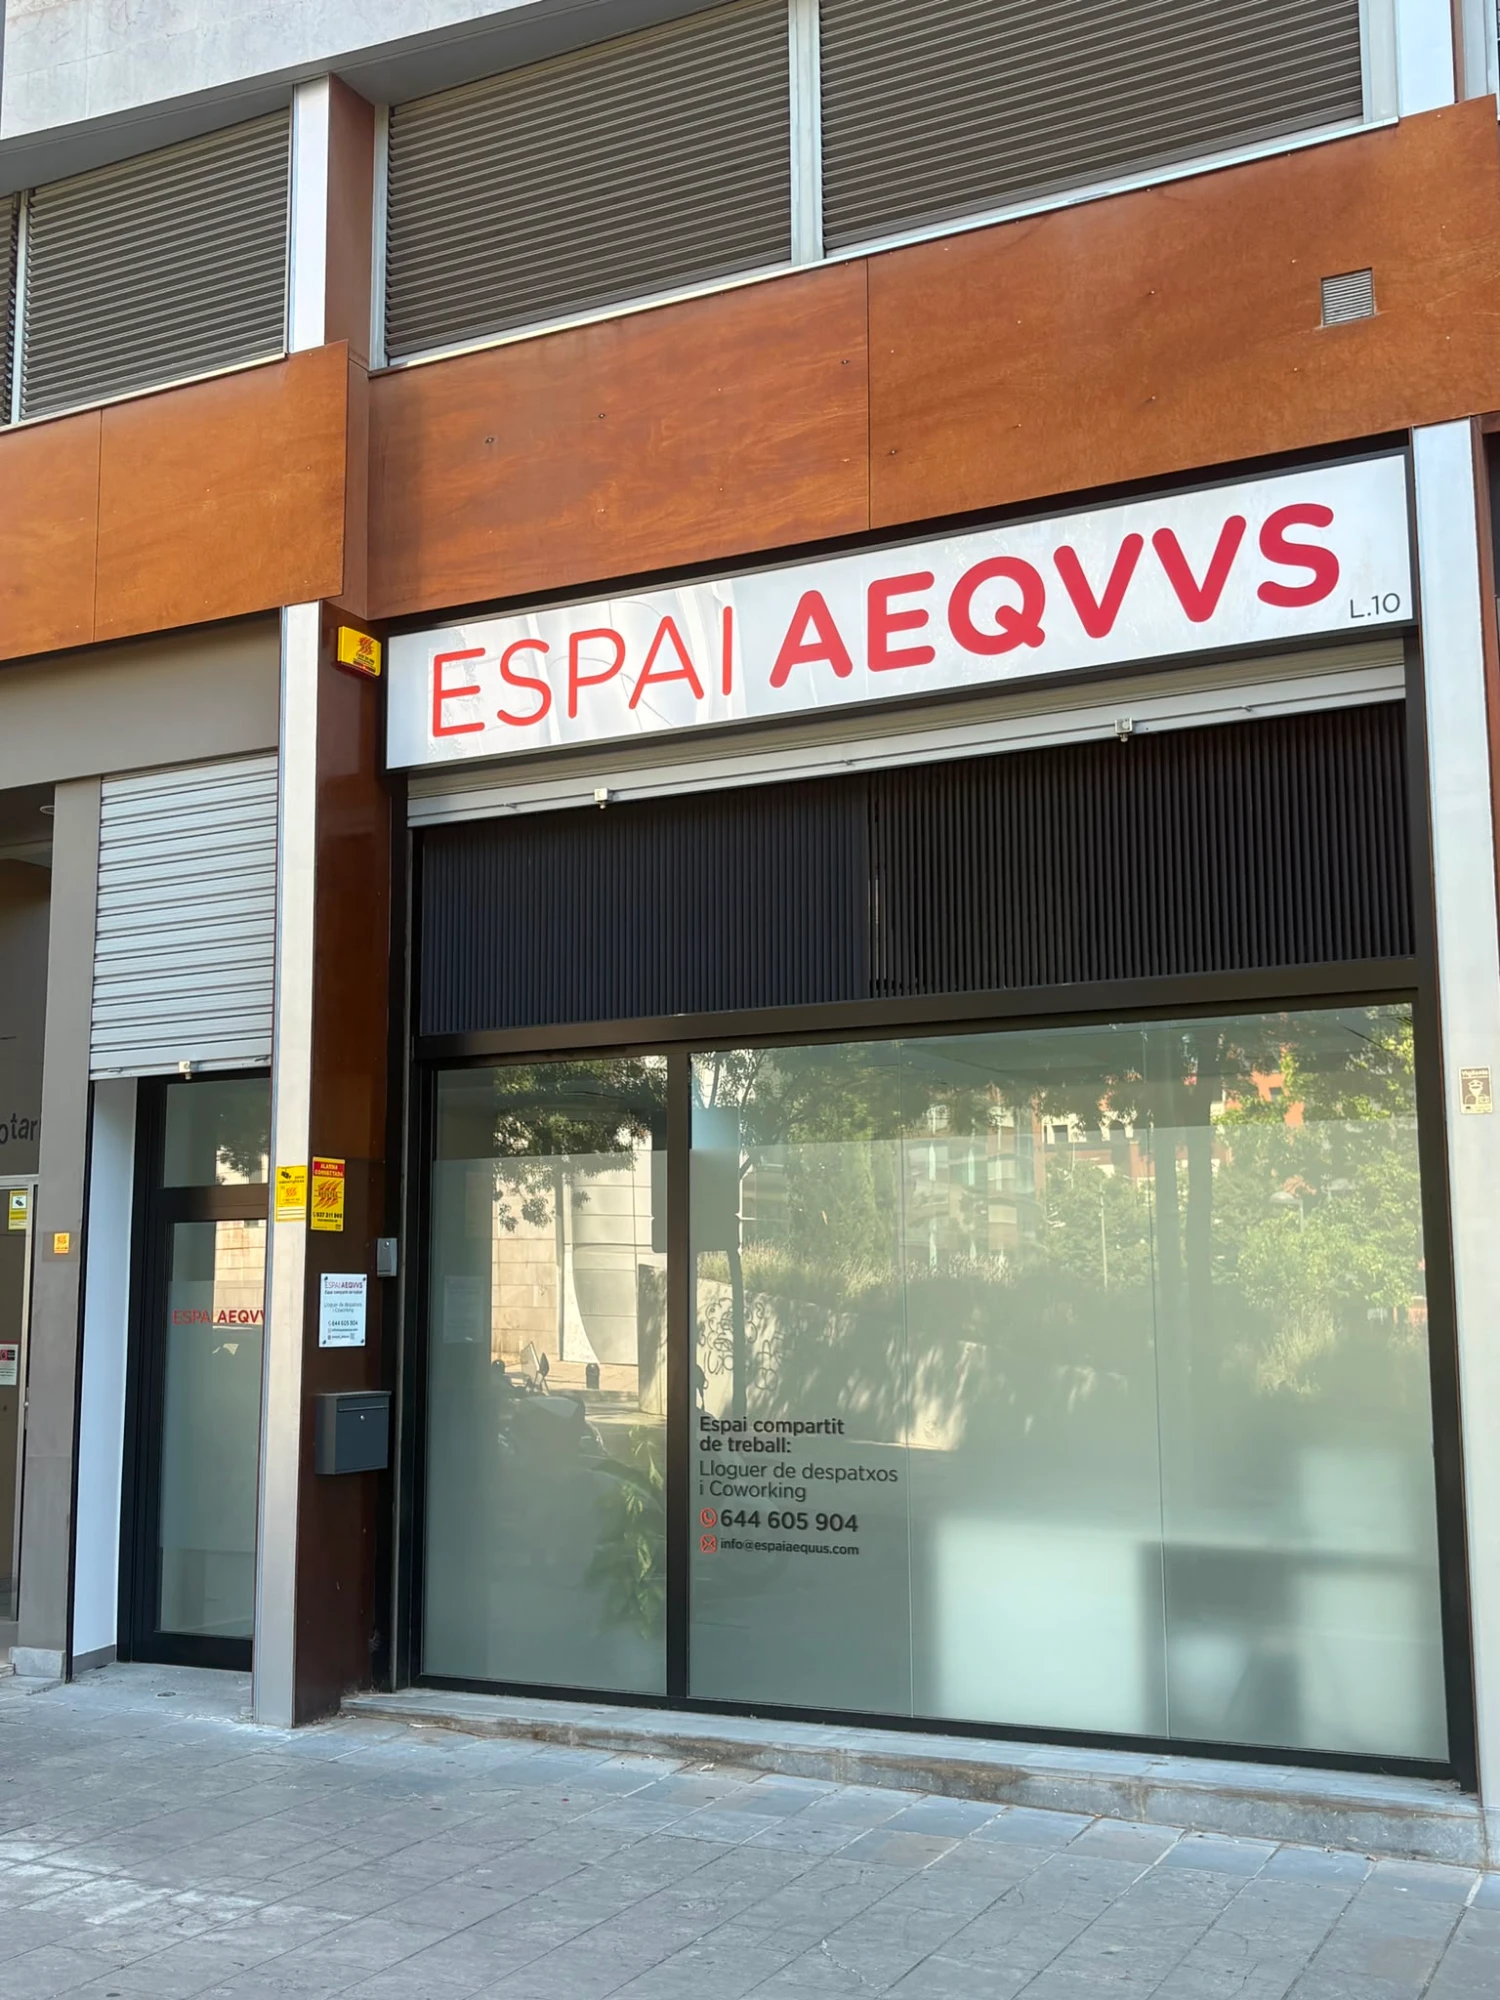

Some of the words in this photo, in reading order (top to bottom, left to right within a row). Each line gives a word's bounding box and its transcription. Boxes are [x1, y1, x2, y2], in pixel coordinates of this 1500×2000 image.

[1350, 592, 1401, 619] L.10
[432, 606, 734, 738] ESPAI
[769, 502, 1341, 688] AEQVVS
[699, 1416, 748, 1435] Espai
[753, 1418, 845, 1436] compartit
[699, 1437, 722, 1451] de
[728, 1438, 793, 1454] treball:
[699, 1460, 768, 1479] Lloguer
[773, 1462, 796, 1479] de
[802, 1463, 899, 1483] despatxos
[699, 1480, 704, 1496] i
[709, 1480, 807, 1503] Coworking
[720, 1509, 762, 1528] 644
[767, 1511, 809, 1531] 605
[815, 1513, 859, 1533] 904
[720, 1538, 860, 1556] info@espaiaequus.com
